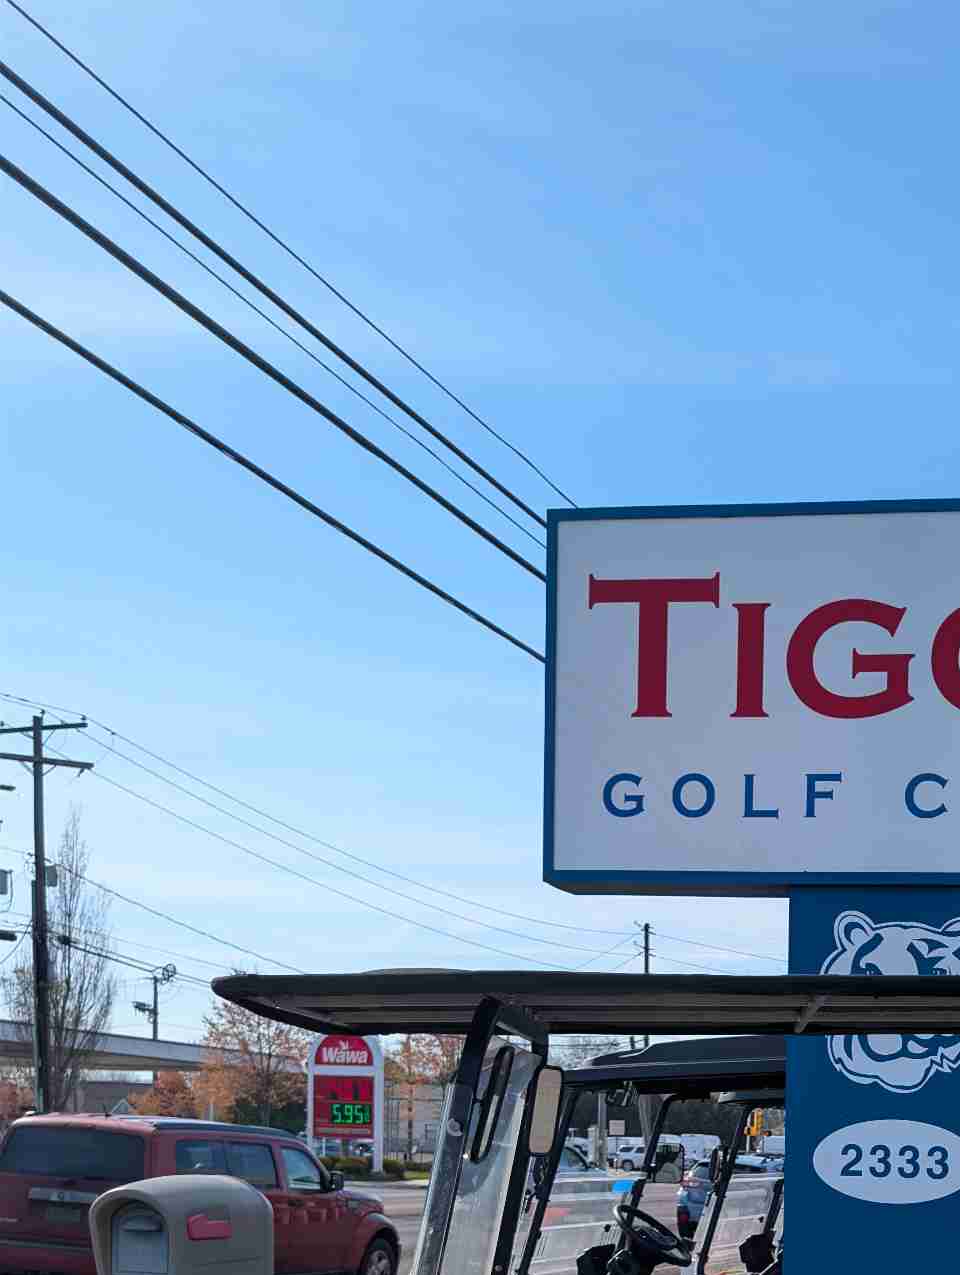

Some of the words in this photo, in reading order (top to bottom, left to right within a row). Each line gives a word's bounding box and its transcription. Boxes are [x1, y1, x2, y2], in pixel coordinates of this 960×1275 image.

[602, 772, 843, 819] GOLF
[322, 1047, 368, 1064] Wawa
[840, 1143, 950, 1180] 2333
